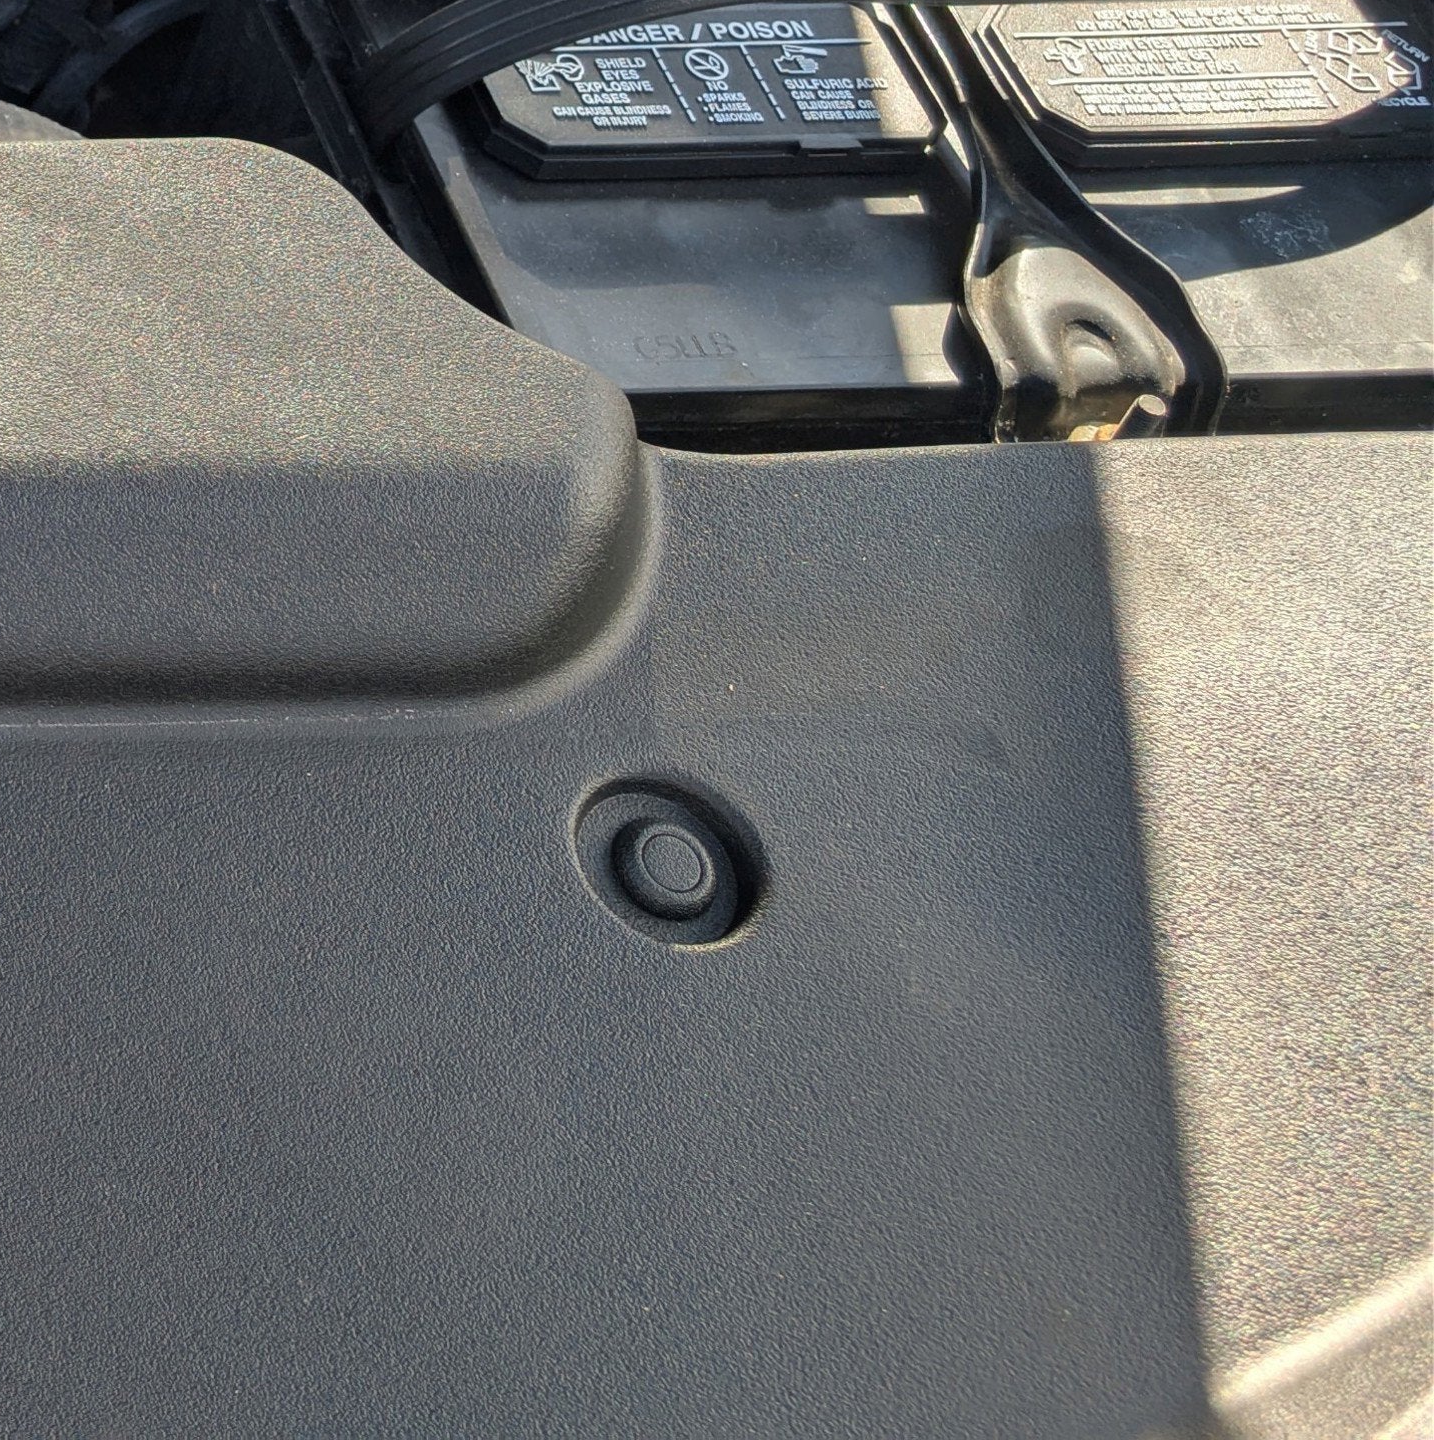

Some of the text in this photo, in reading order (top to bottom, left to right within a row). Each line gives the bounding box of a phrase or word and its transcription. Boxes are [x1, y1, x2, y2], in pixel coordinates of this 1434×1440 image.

[575, 23, 686, 44] ANGER
[708, 20, 815, 41] POISON
[1172, 33, 1264, 50] IMMEDIATELY
[1381, 29, 1431, 63] RETURN
[595, 57, 647, 70] SHIELD
[1101, 62, 1165, 77] MEDICAL
[1166, 61, 1203, 75] HELP
[601, 69, 641, 81] EYES
[574, 80, 654, 93] EXPLOSIVE
[705, 80, 729, 92] NO
[784, 77, 889, 91] SULFURIC ACID
[581, 92, 631, 105] GASES
[791, 90, 855, 101] CAN CAUSE
[552, 104, 673, 117] CAN CAUSE BLINDNESS
[797, 100, 875, 111] BLINDNESS OR
[593, 115, 649, 127] OR INJURY
[802, 109, 882, 122] SEVERE BURNS
